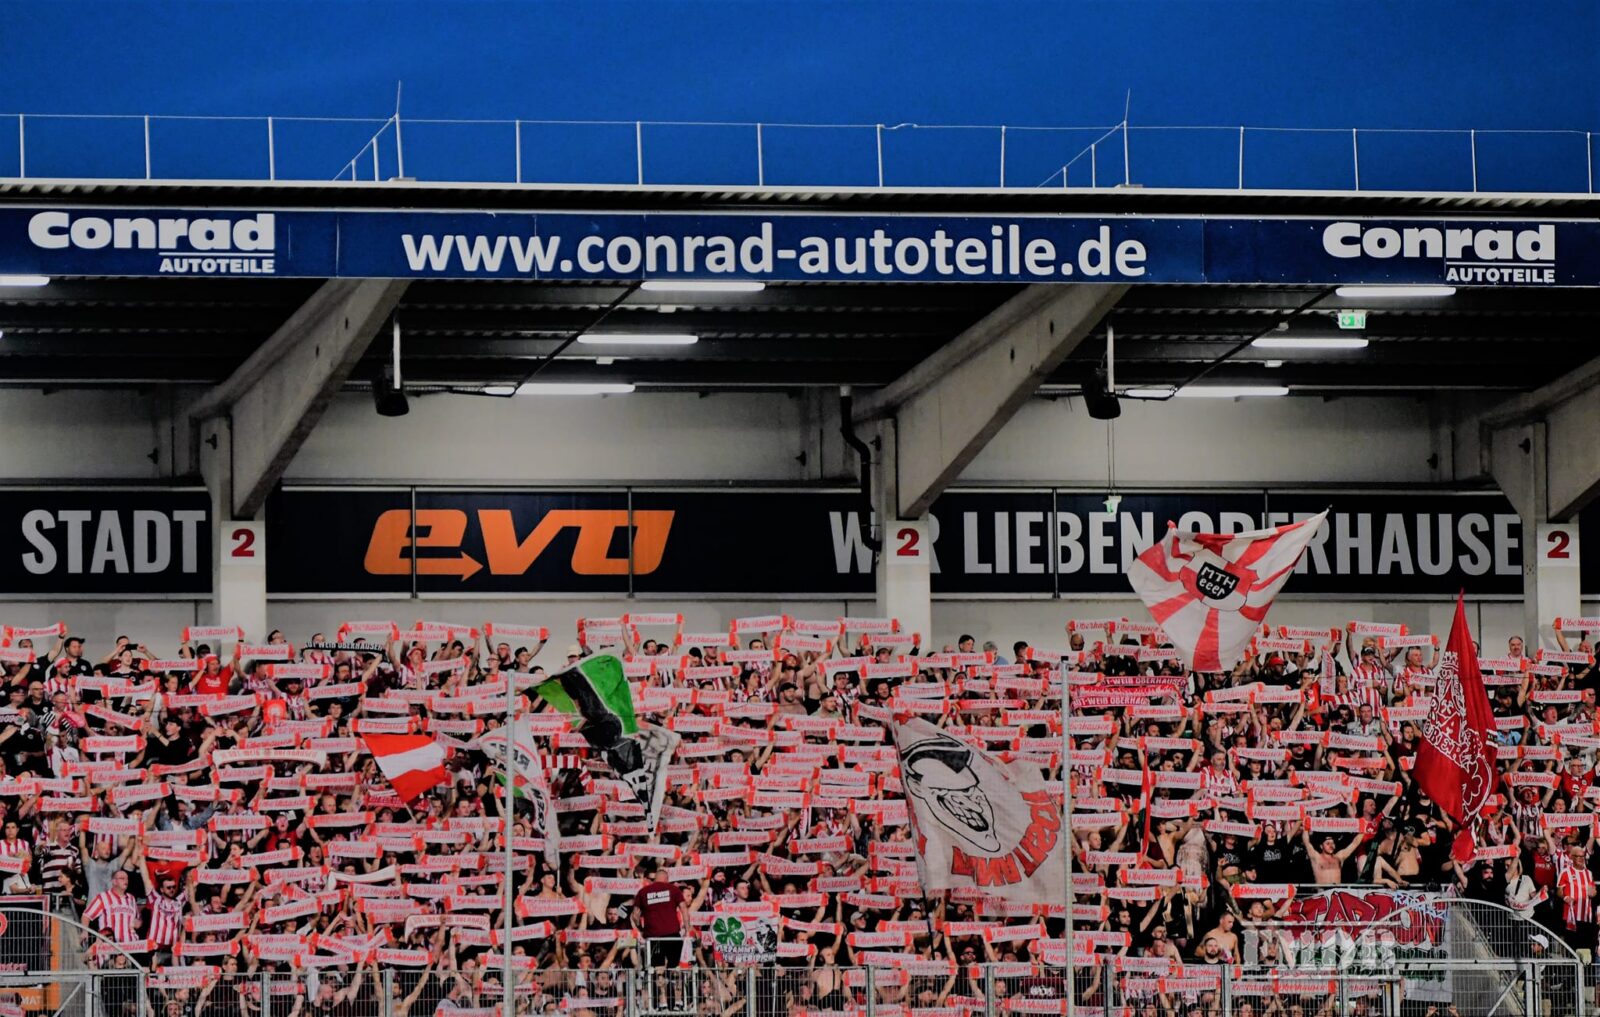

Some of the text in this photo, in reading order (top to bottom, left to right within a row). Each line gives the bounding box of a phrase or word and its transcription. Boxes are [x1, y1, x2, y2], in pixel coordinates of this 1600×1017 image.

[28, 212, 275, 250] Conrad
[1322, 222, 1556, 261] Conrad
[402, 222, 1147, 278] www.conrad-autoteile.de
[159, 258, 275, 273] AUTOTEILE
[1446, 267, 1556, 284] AUTOTEILE
[21, 509, 206, 575] STADT
[231, 528, 255, 557] 2
[364, 509, 675, 576] evo
[896, 528, 920, 556] 2
[963, 511, 1154, 574] LIEBEN
[1547, 530, 1570, 559] 2
[1331, 735, 1375, 749] Oberhausen
[1129, 871, 1174, 881] Oberhausen
[1240, 885, 1286, 896] Oberhausen
